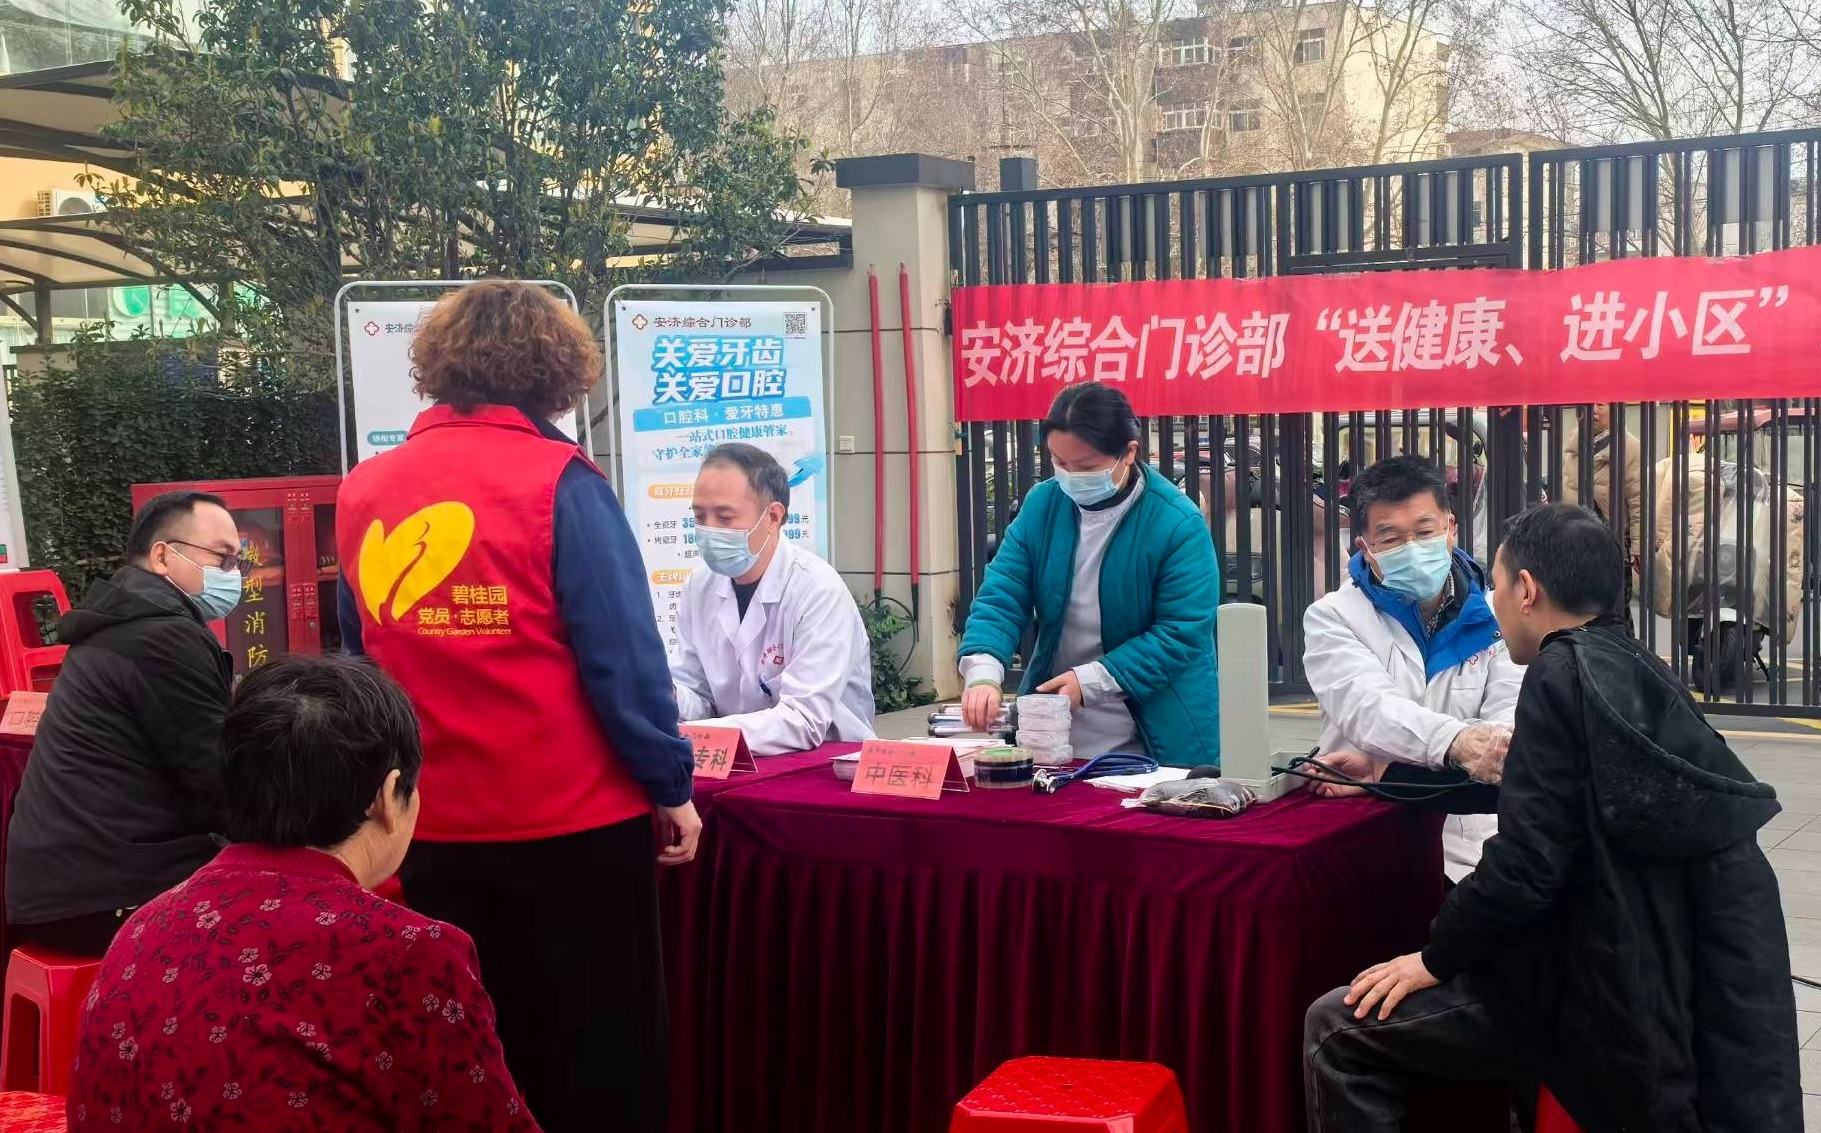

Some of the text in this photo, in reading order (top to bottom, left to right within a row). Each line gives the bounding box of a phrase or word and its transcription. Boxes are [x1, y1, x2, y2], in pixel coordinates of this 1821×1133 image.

[653, 316, 752, 328] 安济综合门诊部
[653, 336, 783, 370] 关爱牙齿
[961, 311, 1290, 388] 安济综合门诊部
[652, 368, 785, 404] 关爱口腔
[451, 585, 508, 605] 碧桂园
[417, 627, 445, 637] Country
[446, 627, 475, 636] Garden
[866, 762, 934, 788] 中医科
